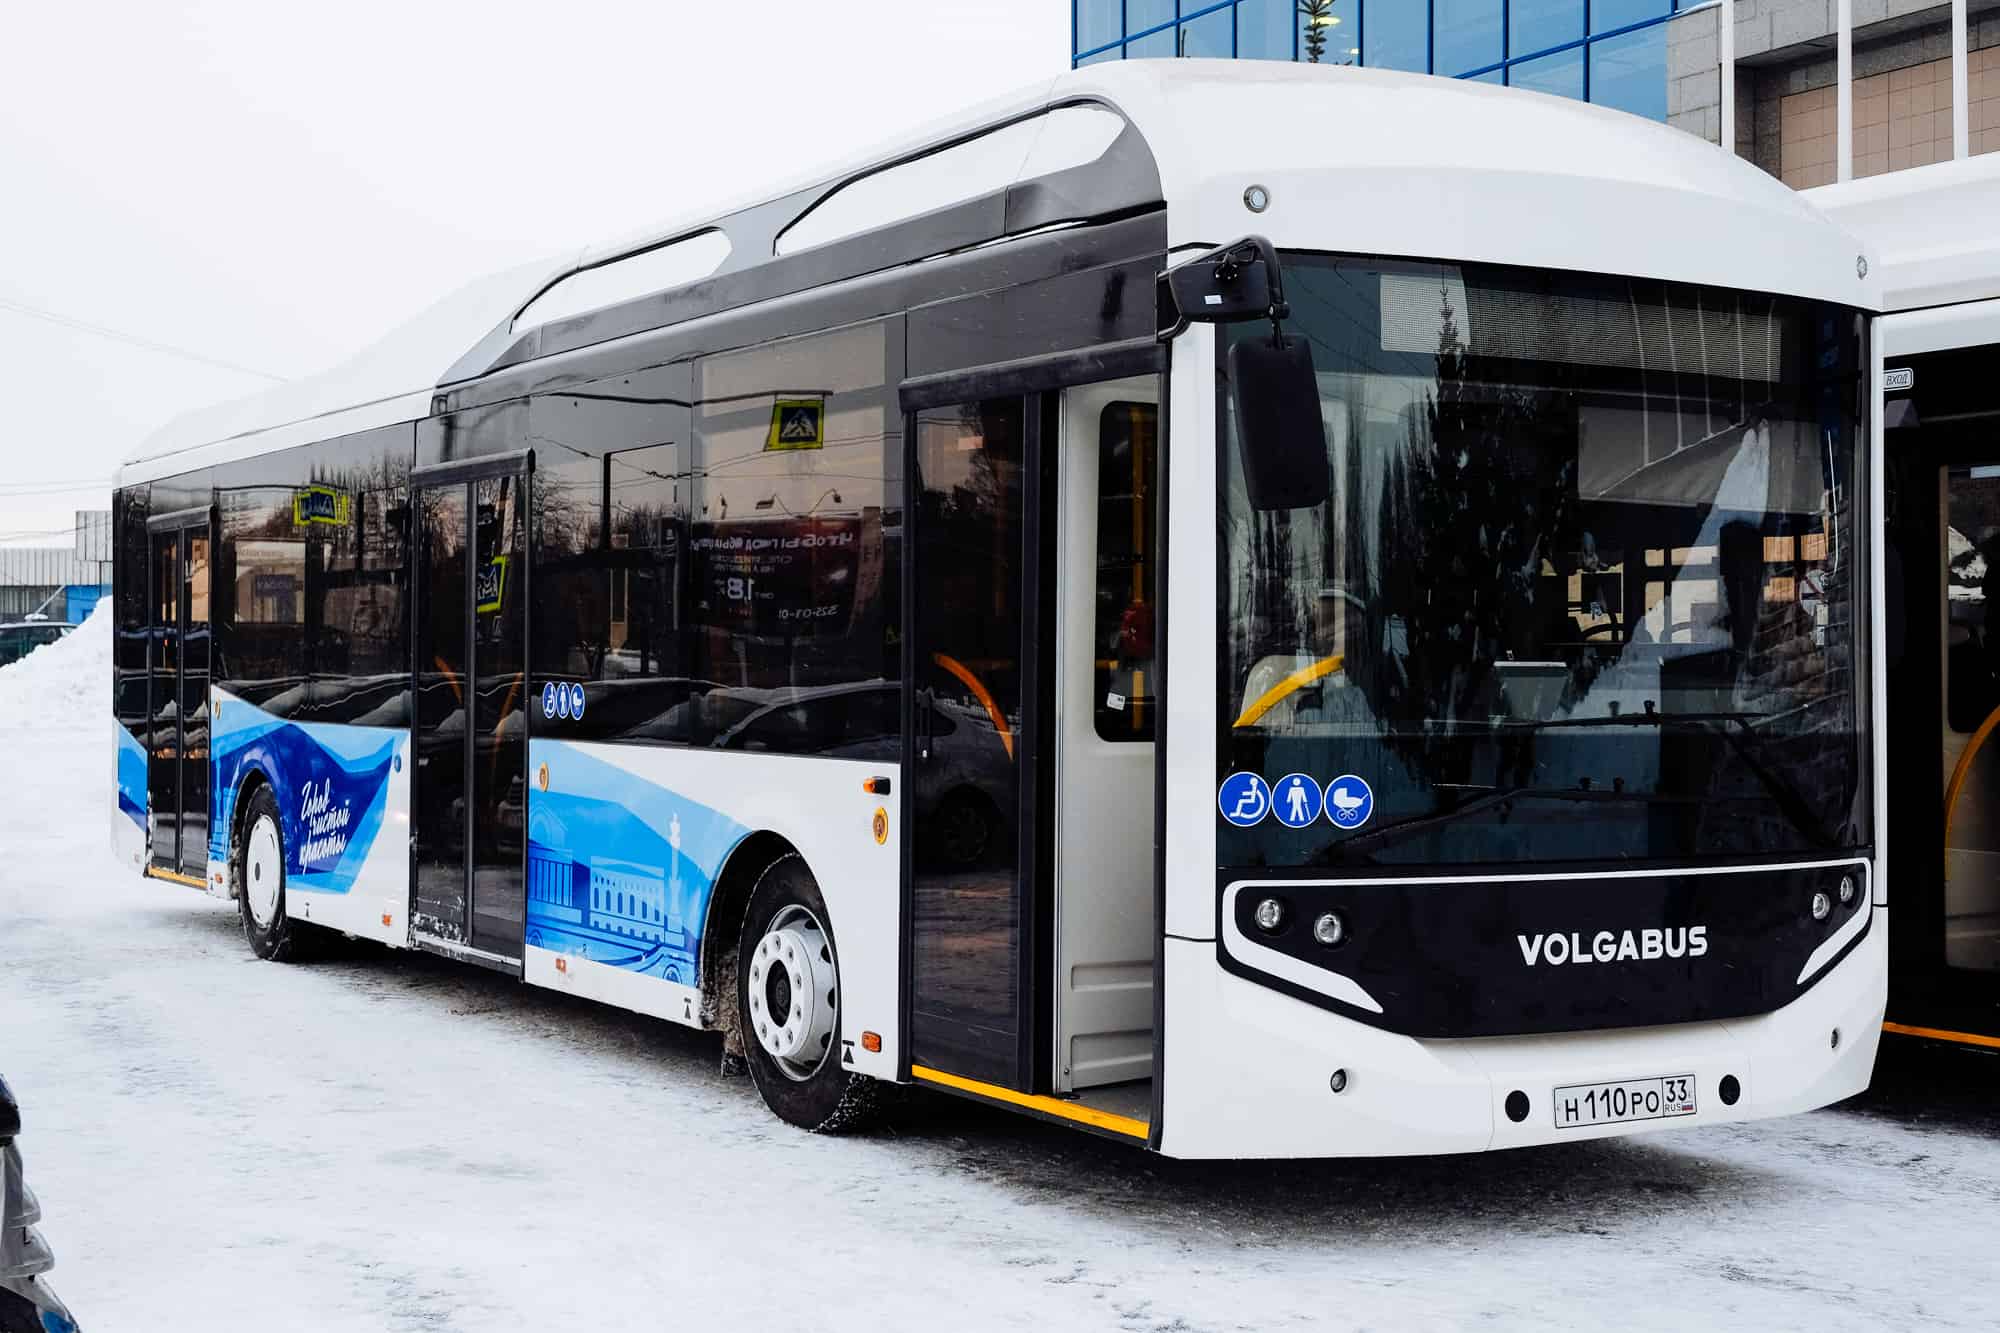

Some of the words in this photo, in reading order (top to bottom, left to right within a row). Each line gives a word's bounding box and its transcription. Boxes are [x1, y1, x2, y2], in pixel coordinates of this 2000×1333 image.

[301, 777, 330, 828] Город
[312, 799, 350, 835] чистой
[299, 829, 347, 875] красоты
[1516, 925, 1709, 967] VOLGABUS
[1664, 1104, 1681, 1112] RUS
[1666, 1079, 1688, 1103] 33
